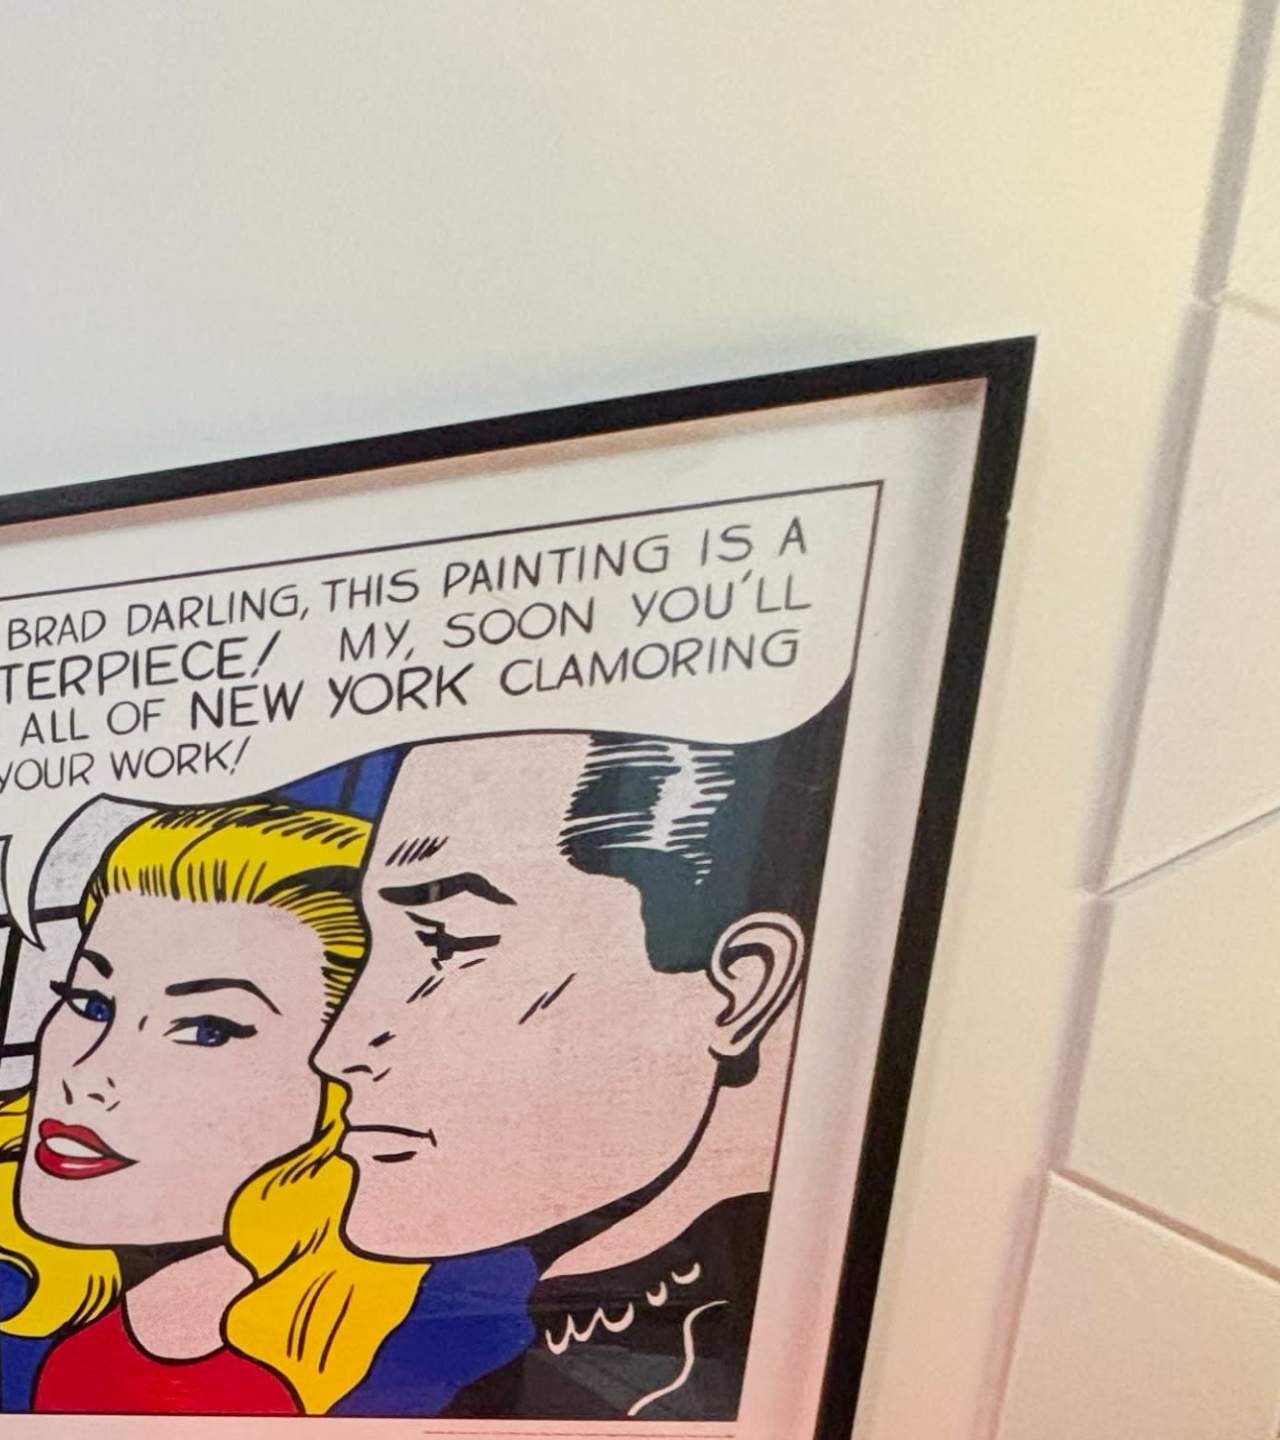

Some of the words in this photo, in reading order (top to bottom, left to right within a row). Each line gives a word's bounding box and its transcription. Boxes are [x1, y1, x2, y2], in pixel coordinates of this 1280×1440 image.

[8, 609, 107, 652] BRAD
[127, 584, 310, 637] DARLING,
[322, 569, 420, 613] THIS
[442, 534, 670, 598] PAINTING
[700, 524, 753, 567] IS
[778, 516, 807, 557] A
[340, 619, 416, 663] MY,
[442, 596, 595, 649] SOON
[631, 568, 812, 627] YOU'LL
[20, 707, 90, 747] ALL
[106, 698, 166, 737] OF
[190, 679, 304, 731] NEW
[328, 663, 475, 719] YORK
[499, 629, 801, 697] CLAMORING
[109, 735, 252, 781] WORK!
